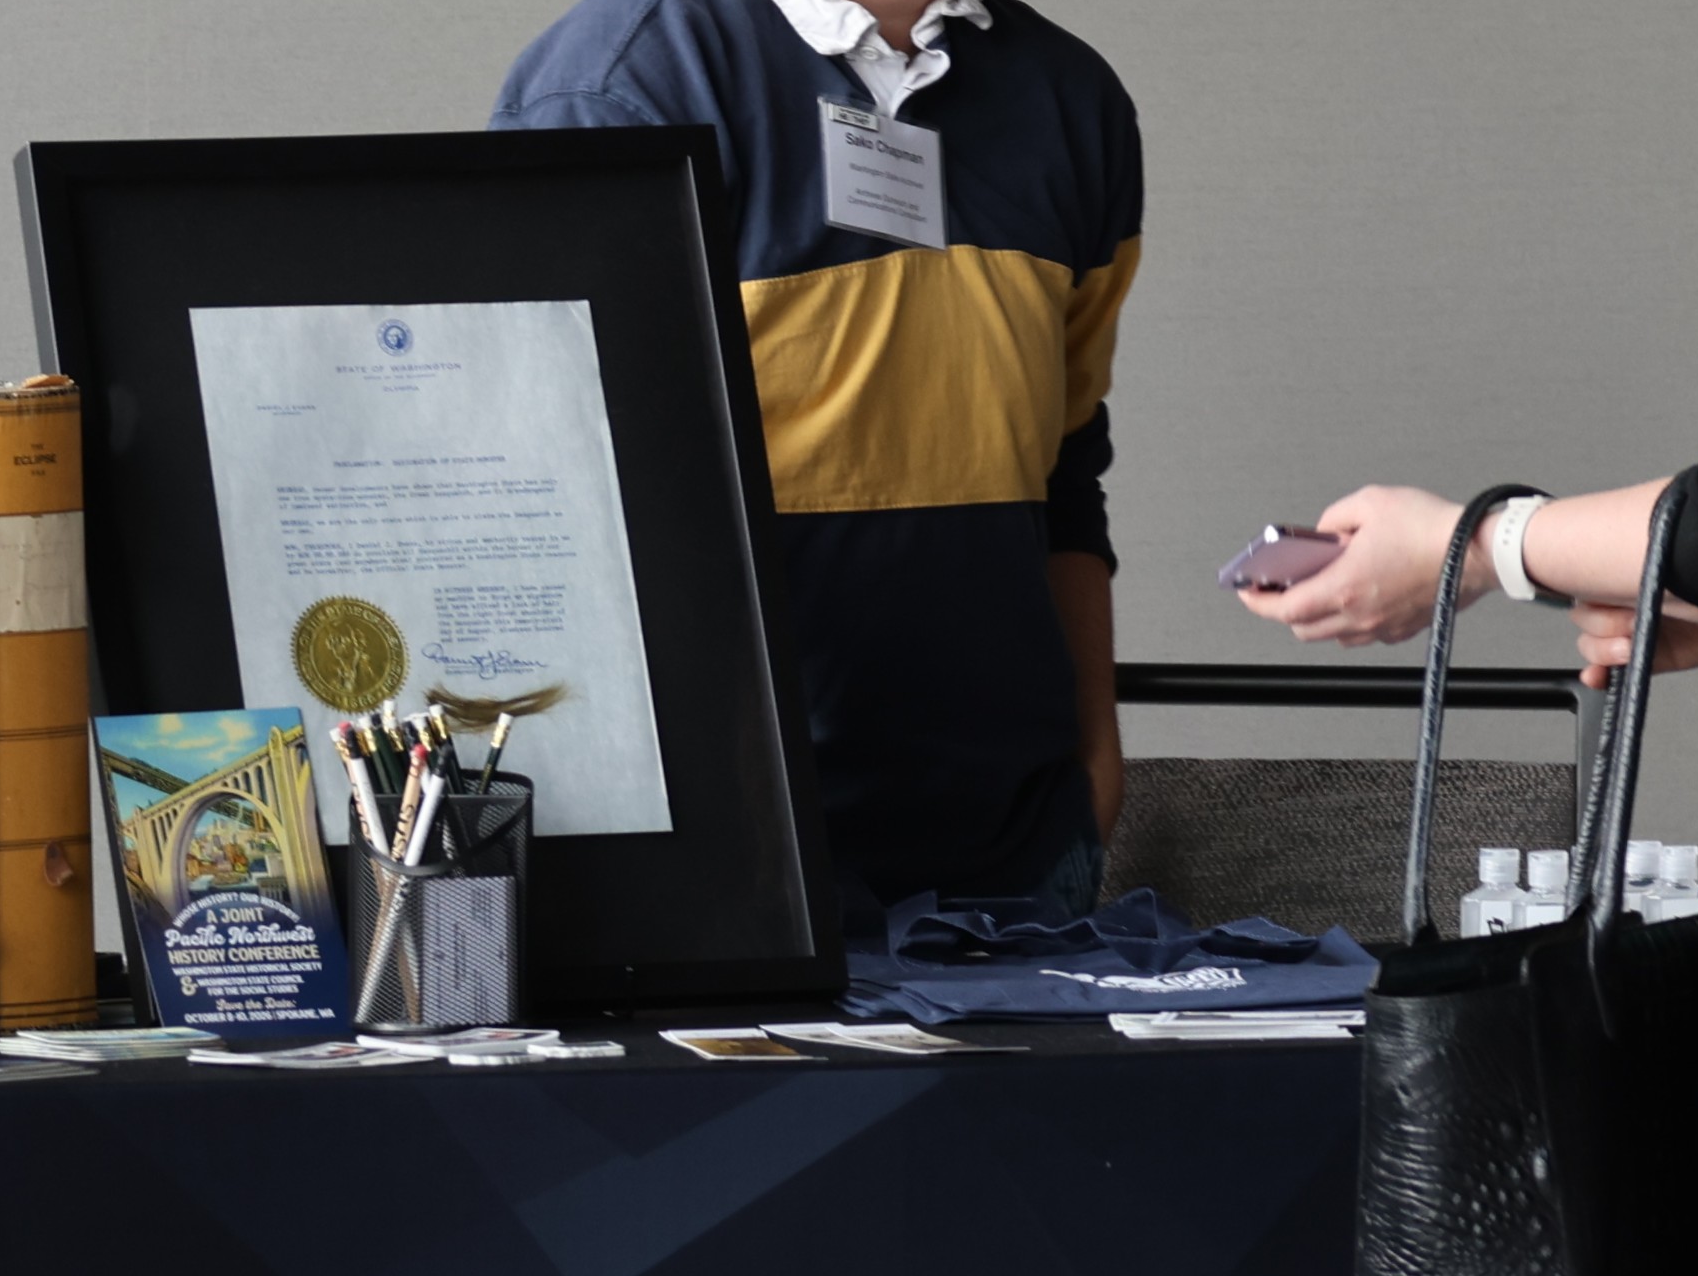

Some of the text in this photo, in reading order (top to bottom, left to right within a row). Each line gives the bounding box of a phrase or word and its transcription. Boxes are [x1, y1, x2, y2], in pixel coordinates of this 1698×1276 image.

[389, 362, 462, 372] WASHINGTON
[13, 453, 57, 467] ECLIPSE
[239, 892, 260, 904] OUR
[206, 906, 264, 924] A JOINT
[164, 922, 316, 948] Pacific Northwest
[167, 943, 322, 965] HISTORY CONFERENCE
[172, 961, 323, 977] WASHINGTON STATE HISTORICAL SOCIETY
[179, 974, 305, 997] & WASHINGTON STATE COUNCIL
[207, 984, 300, 997] FOR THE SOCIAL STUDIES
[215, 998, 244, 1012] Save
[244, 998, 263, 1011] the
[183, 1012, 227, 1024] OCTOBER
[317, 1007, 336, 1019] WA
